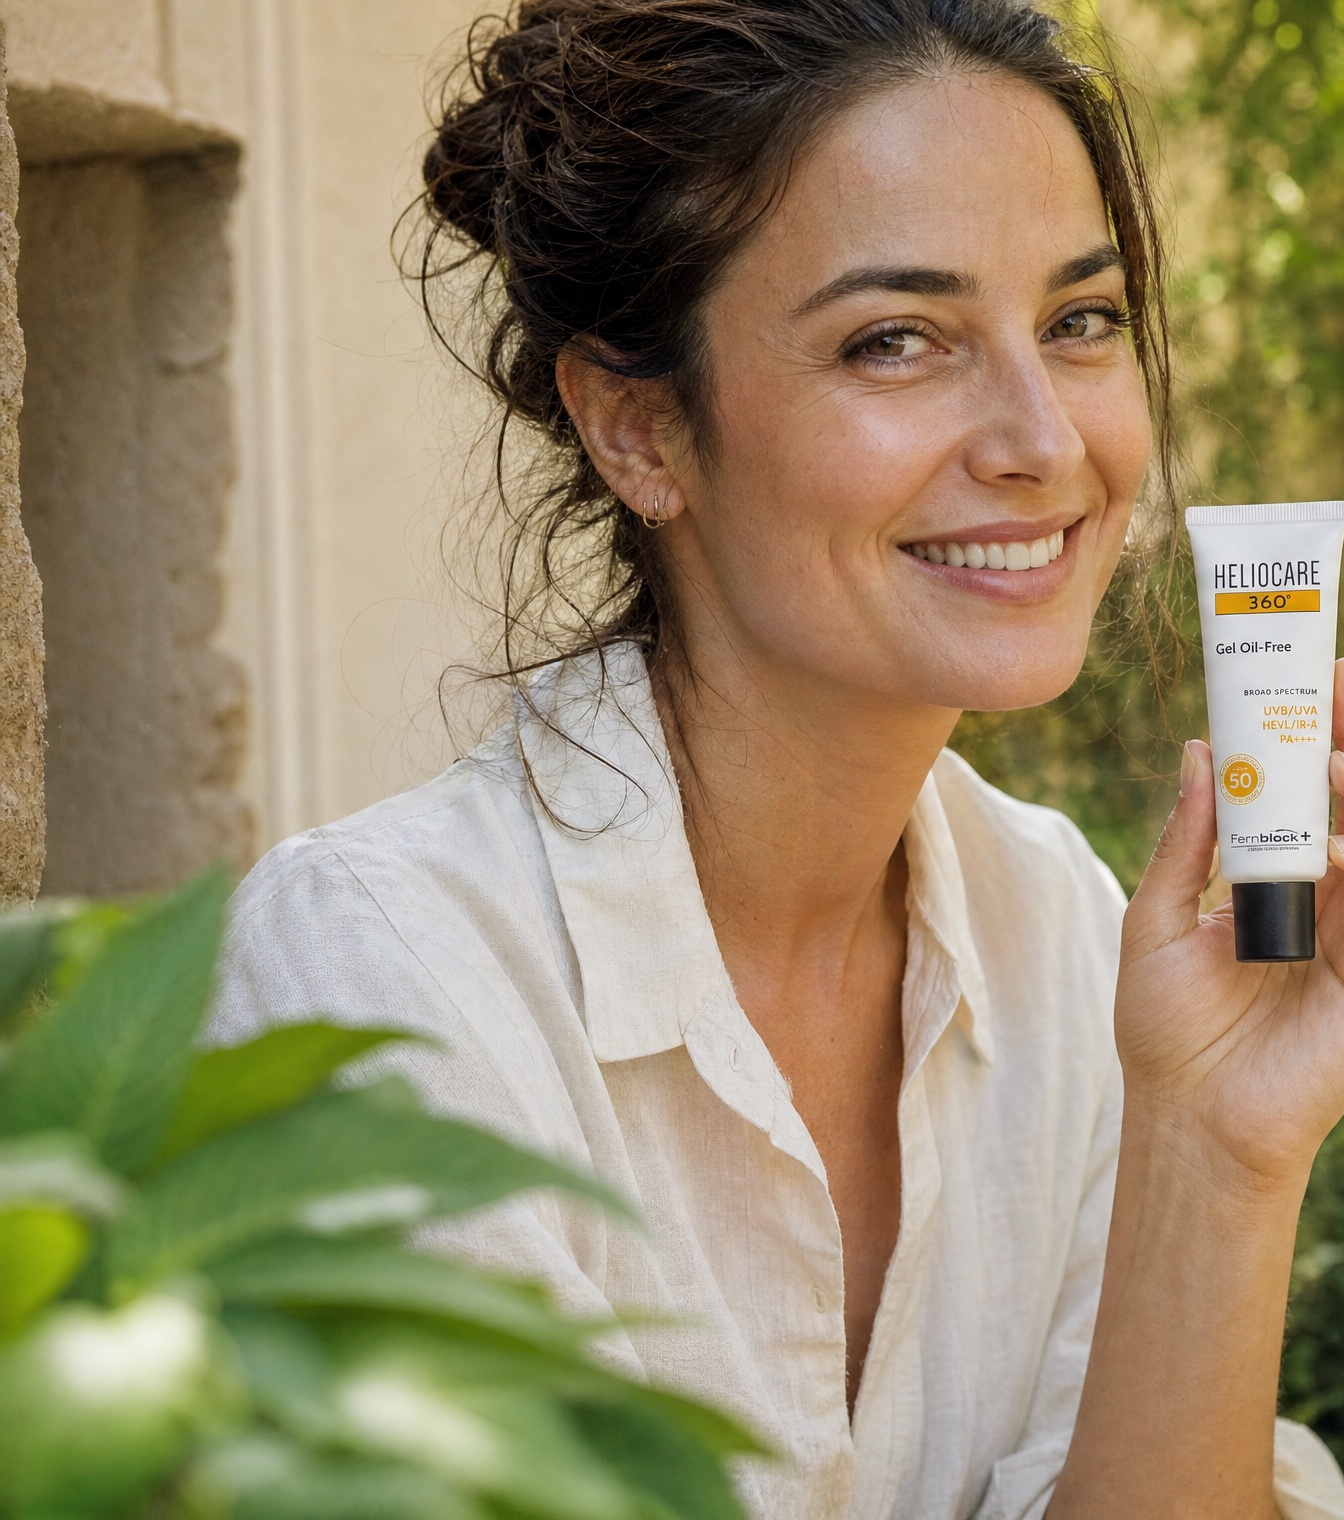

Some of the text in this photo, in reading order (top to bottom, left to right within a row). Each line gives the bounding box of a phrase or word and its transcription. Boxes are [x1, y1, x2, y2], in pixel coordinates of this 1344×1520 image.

[1215, 560, 1321, 589] HELIOCARE
[1248, 594, 1292, 610] 360°
[1216, 641, 1292, 654] Gel Oil-Free
[1274, 688, 1318, 696] SPECTRUM
[1263, 705, 1318, 717] UVB/UVA
[1262, 720, 1318, 731] HEVL/IR-A
[1280, 734, 1317, 744] PA++++
[1229, 772, 1253, 789] 50
